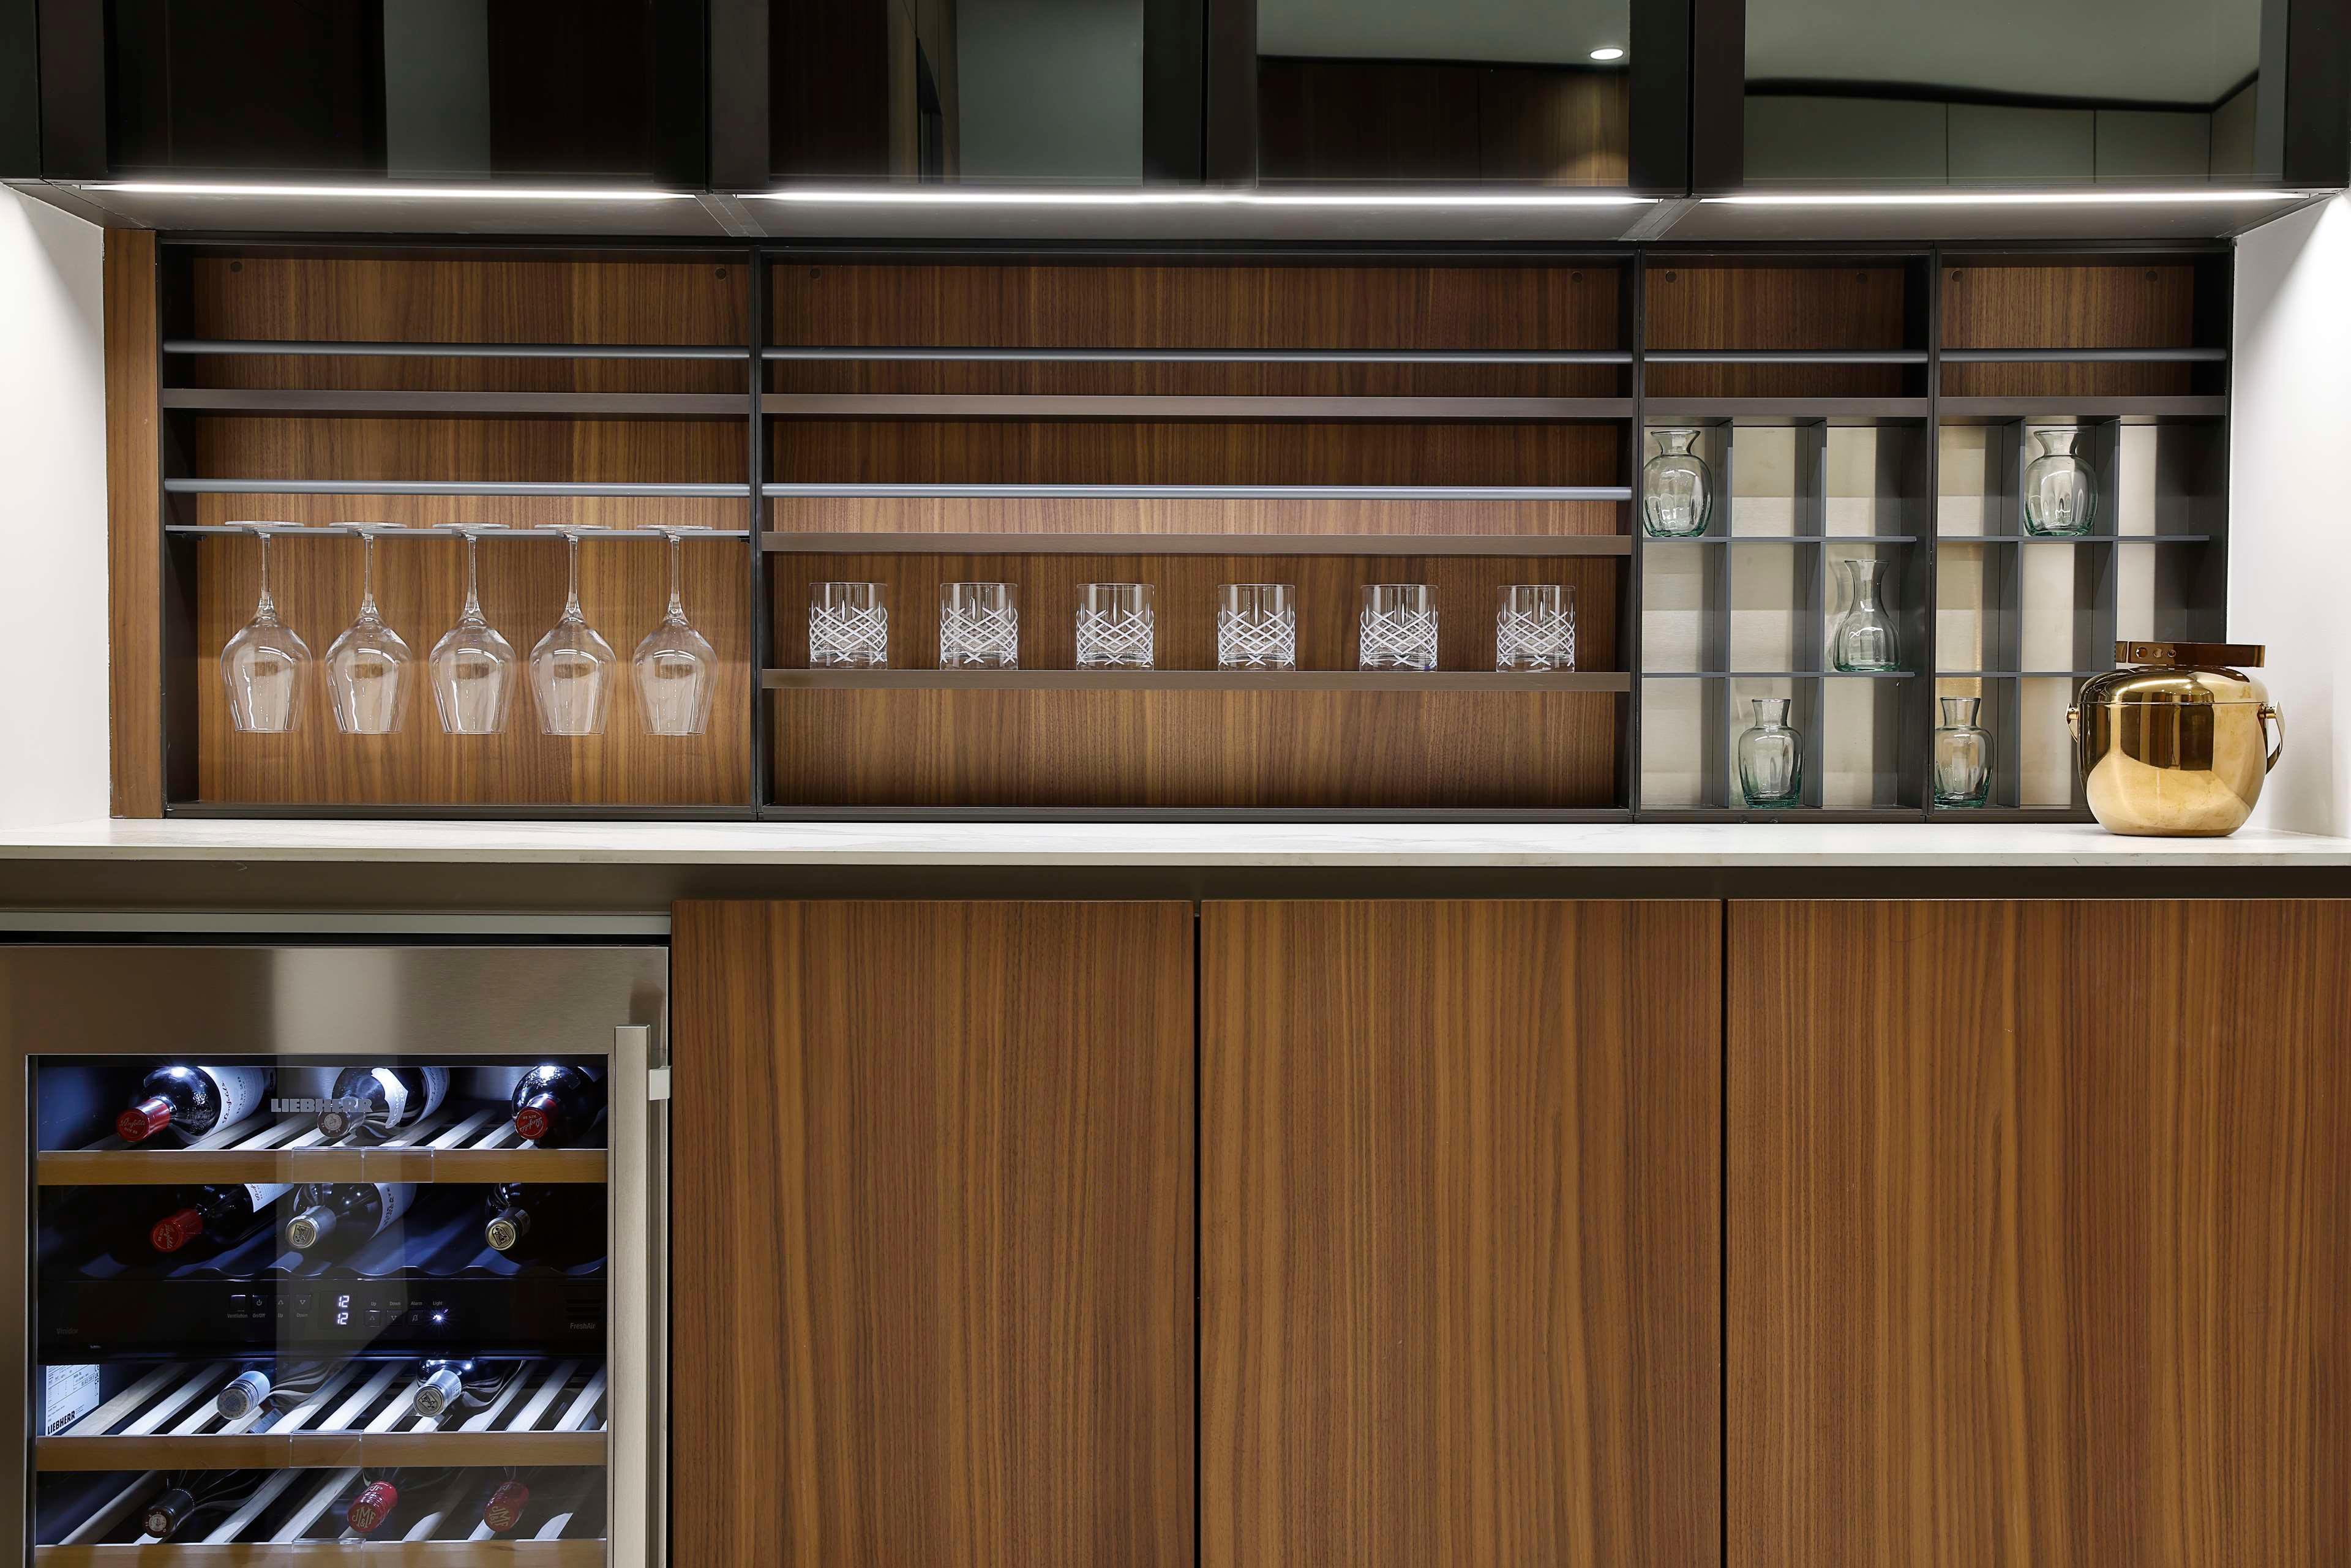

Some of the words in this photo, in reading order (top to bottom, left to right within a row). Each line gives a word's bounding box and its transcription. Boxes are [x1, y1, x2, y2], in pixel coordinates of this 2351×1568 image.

[271, 1098, 373, 1112] LIEBHERR
[339, 1295, 350, 1308] 12
[337, 1313, 349, 1325] 12
[48, 1411, 75, 1435] LIEBHERR
